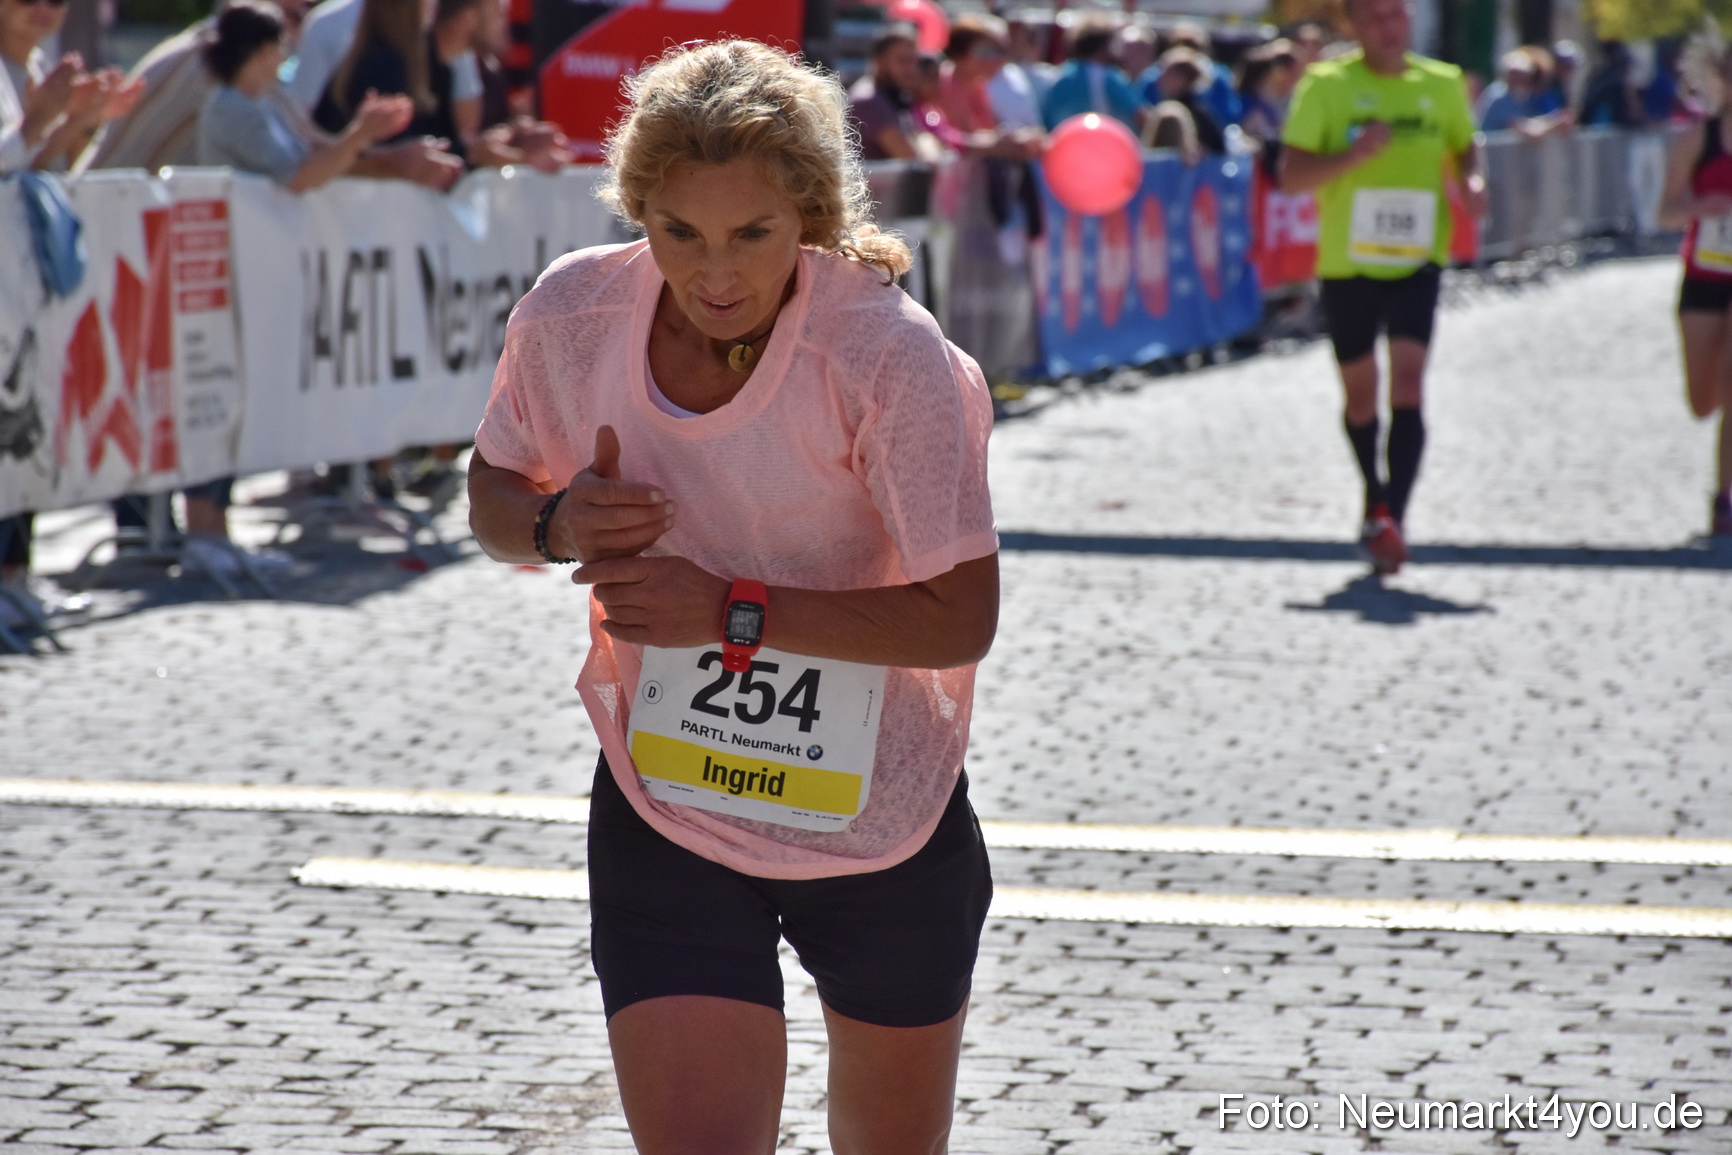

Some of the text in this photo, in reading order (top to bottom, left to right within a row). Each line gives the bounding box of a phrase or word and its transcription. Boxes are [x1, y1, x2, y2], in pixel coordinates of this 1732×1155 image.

[647, 686, 656, 699] D
[690, 651, 821, 733] 254
[680, 719, 728, 743] PARTL
[731, 733, 801, 757] Neumarkt
[702, 755, 786, 797] Ingrid
